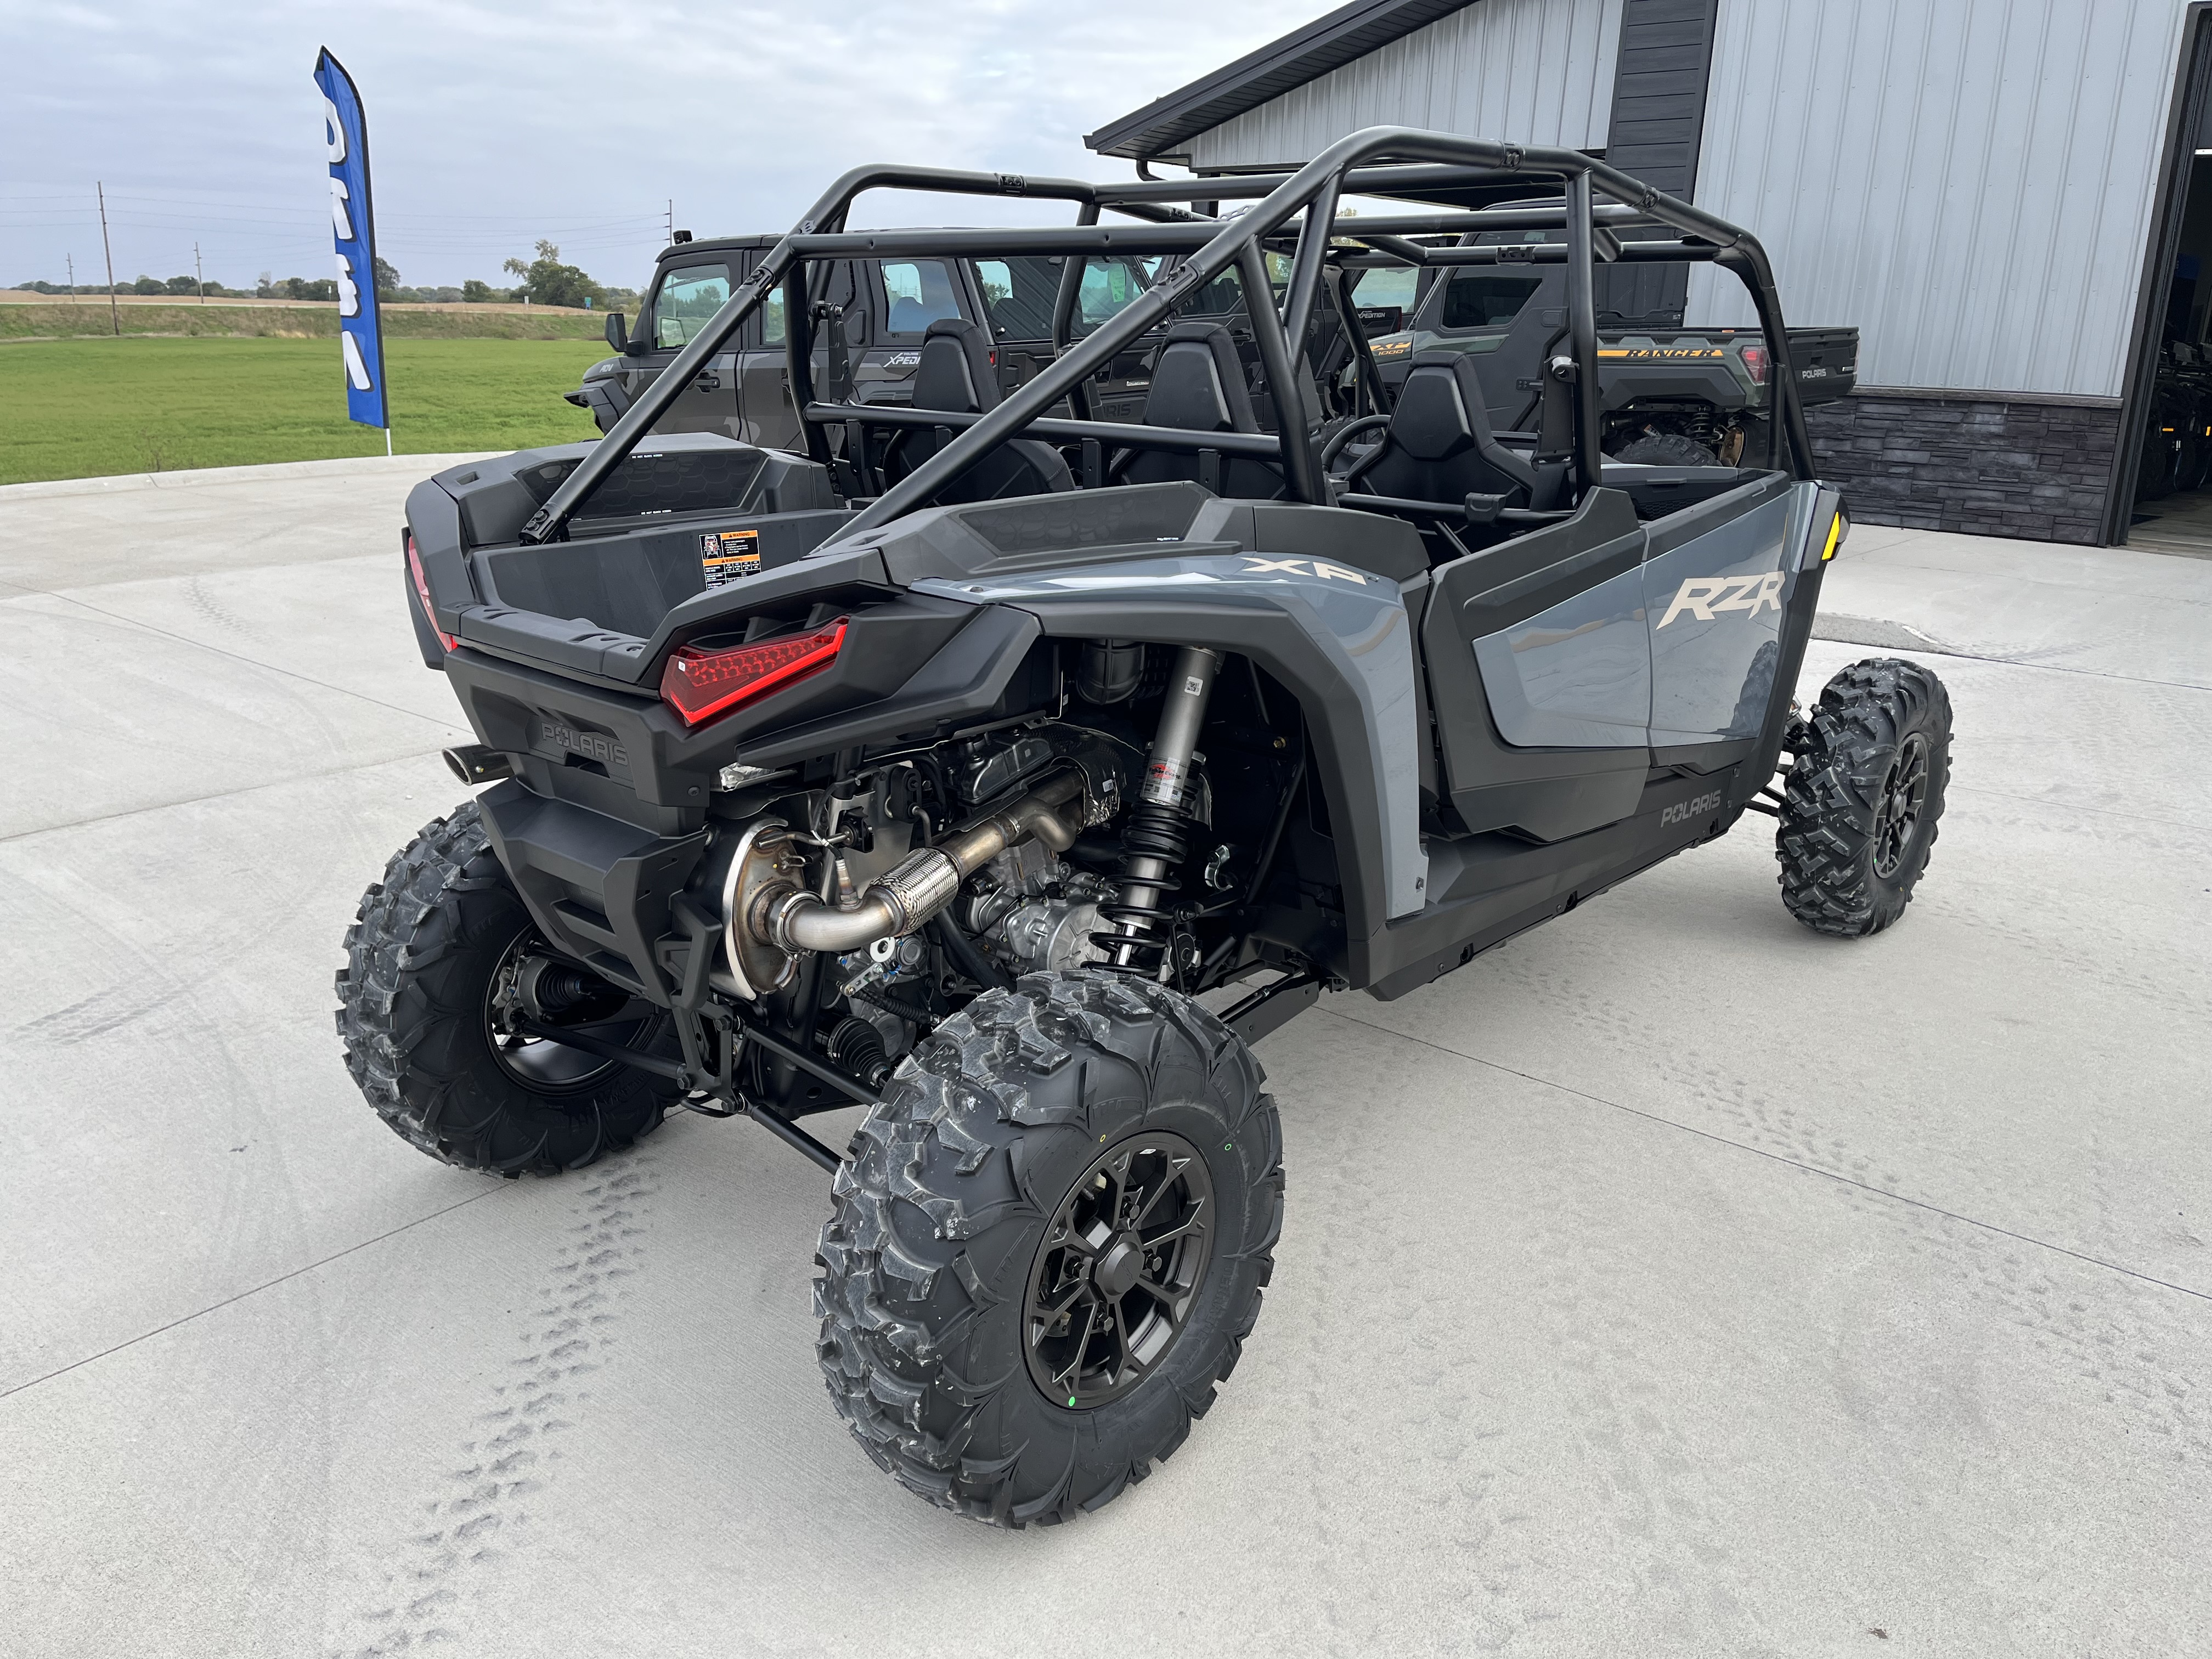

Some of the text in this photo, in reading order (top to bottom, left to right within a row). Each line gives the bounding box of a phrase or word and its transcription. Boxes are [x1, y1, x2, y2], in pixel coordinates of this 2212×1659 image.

[882, 352, 922, 368] XPEDI
[1626, 349, 1714, 357] RANGER
[1802, 368, 1827, 379] POLARIS
[1239, 556, 1368, 586] XP
[1656, 571, 1786, 630] RZR
[540, 722, 629, 766] POLARIS
[1660, 789, 1722, 828] POLARIS
